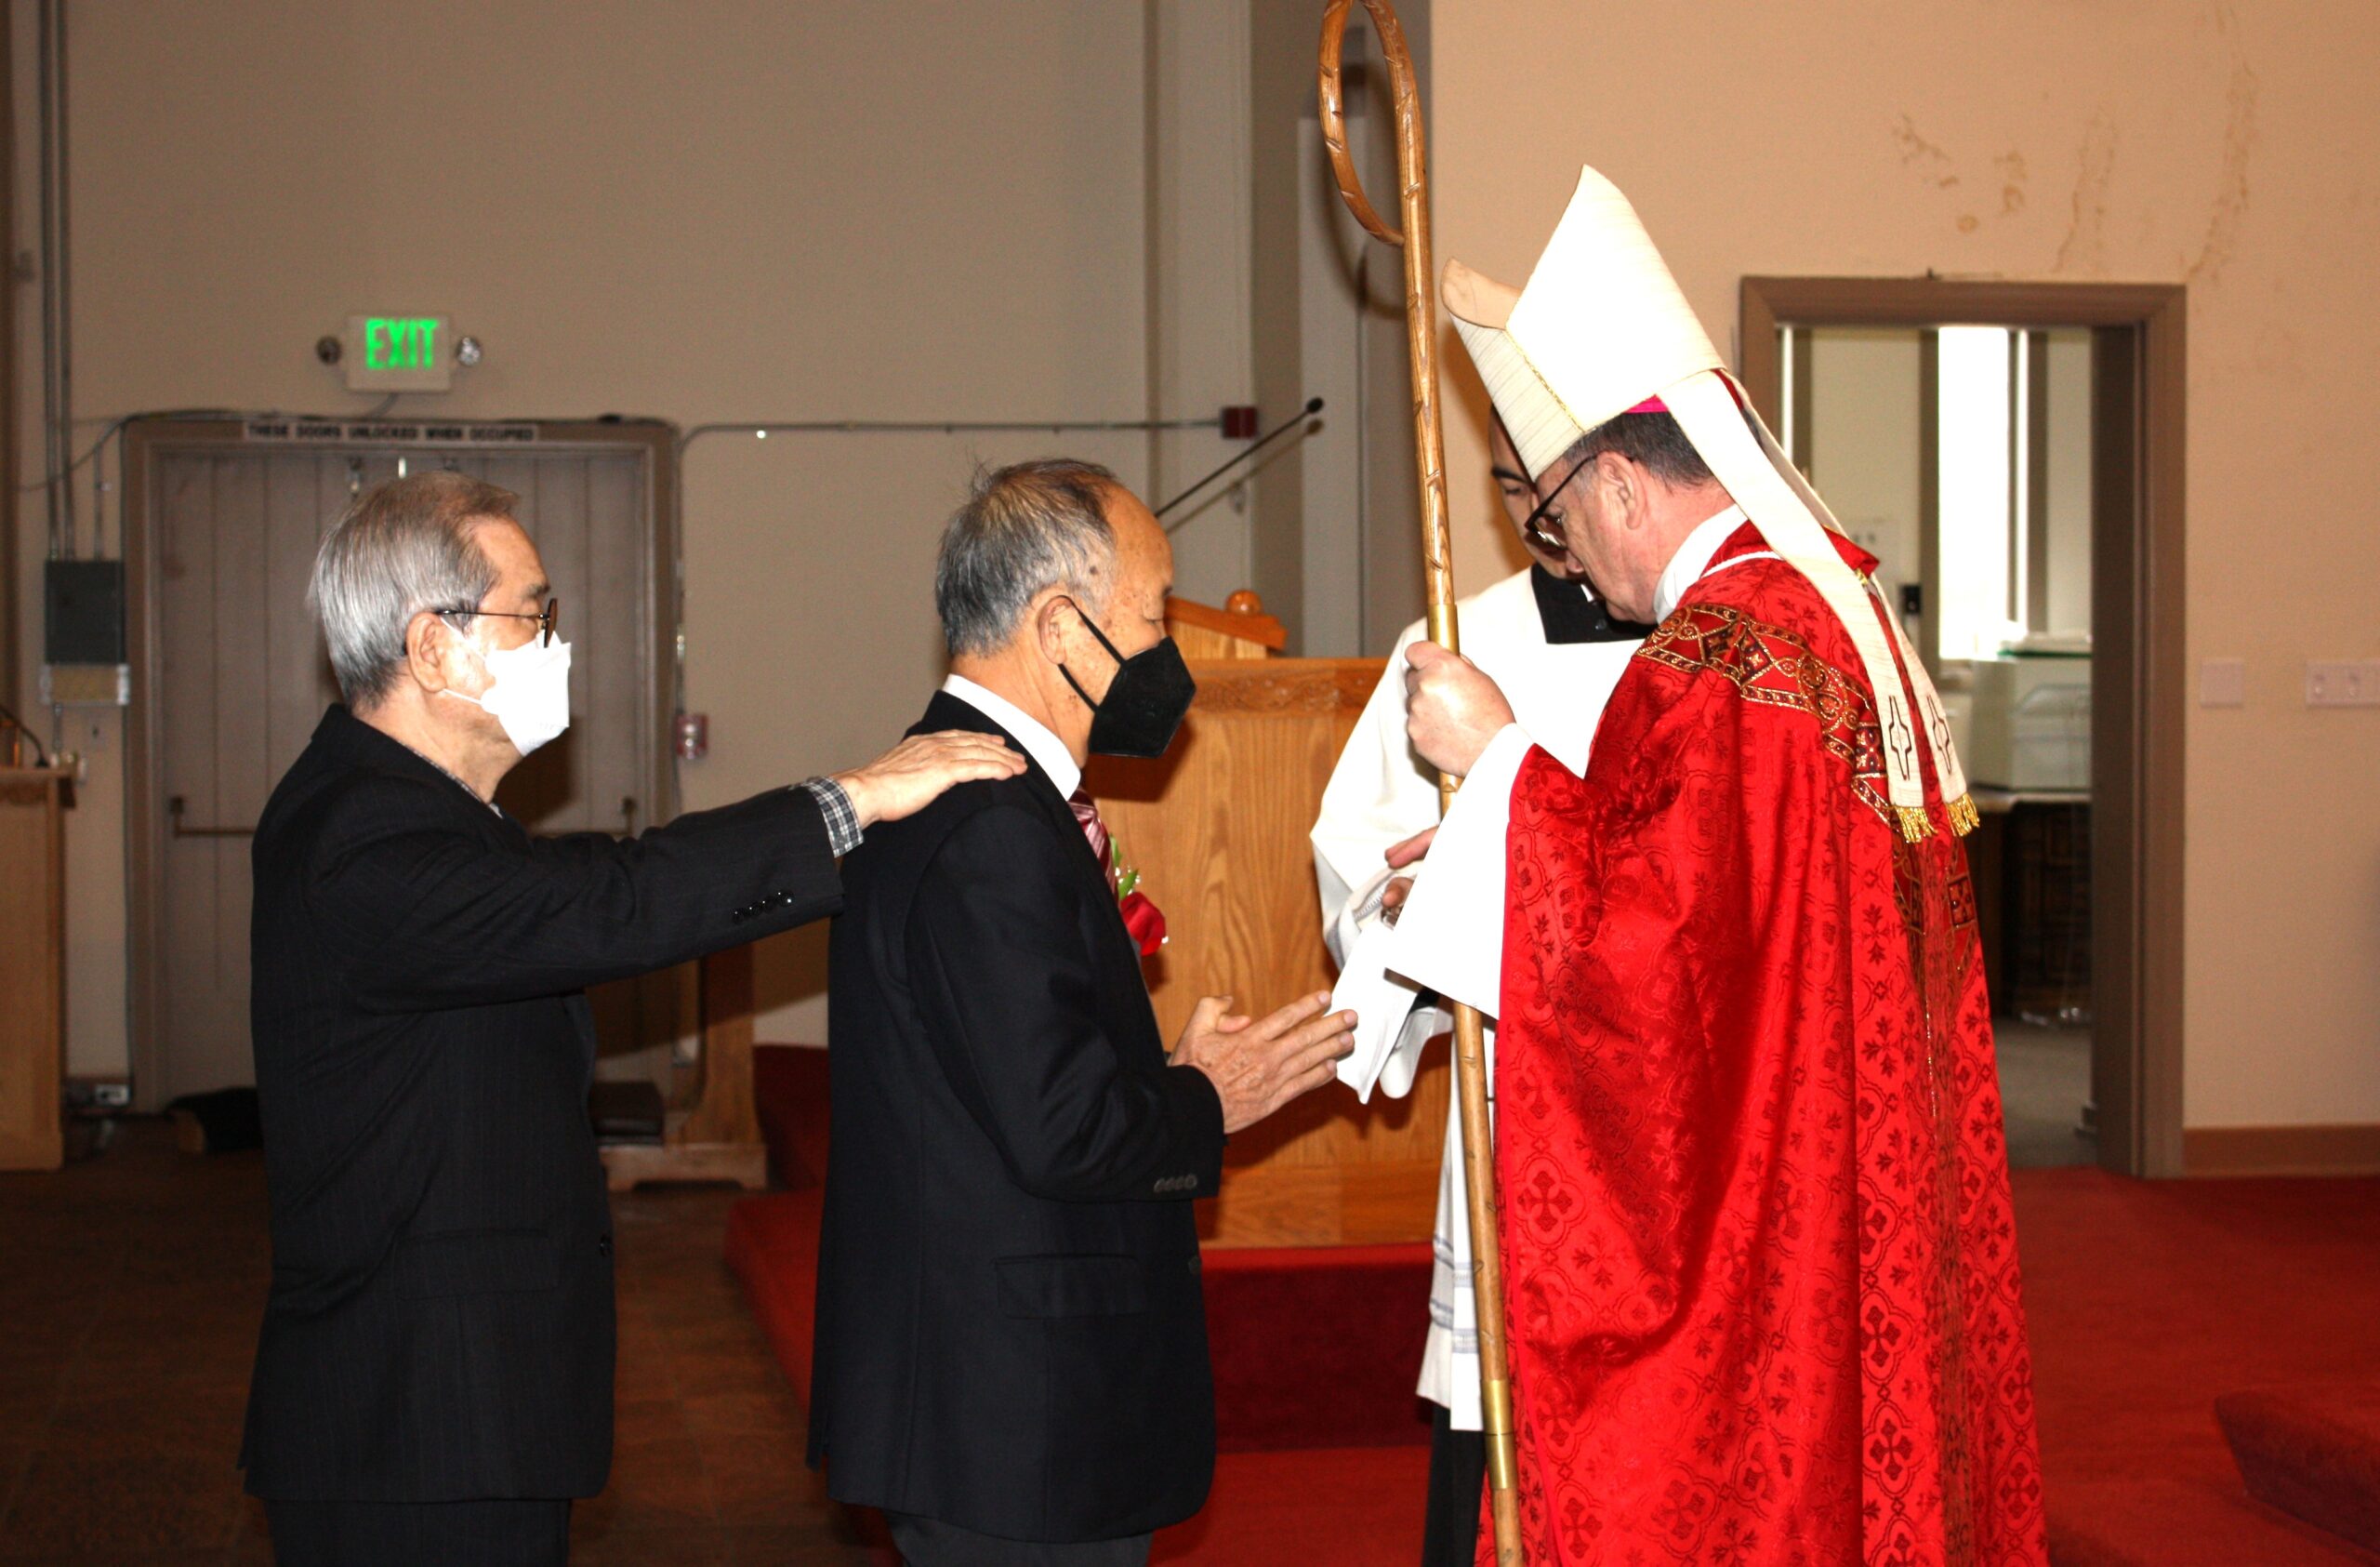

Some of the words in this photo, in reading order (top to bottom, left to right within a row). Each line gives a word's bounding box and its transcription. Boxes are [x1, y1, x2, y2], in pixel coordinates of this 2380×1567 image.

[365, 317, 439, 370] EXIT
[248, 425, 288, 436] THESE
[296, 426, 342, 437] DOORS
[348, 426, 417, 438] UNLOCKED
[425, 428, 462, 439] WHEN
[469, 428, 534, 441] OCCUPIED
